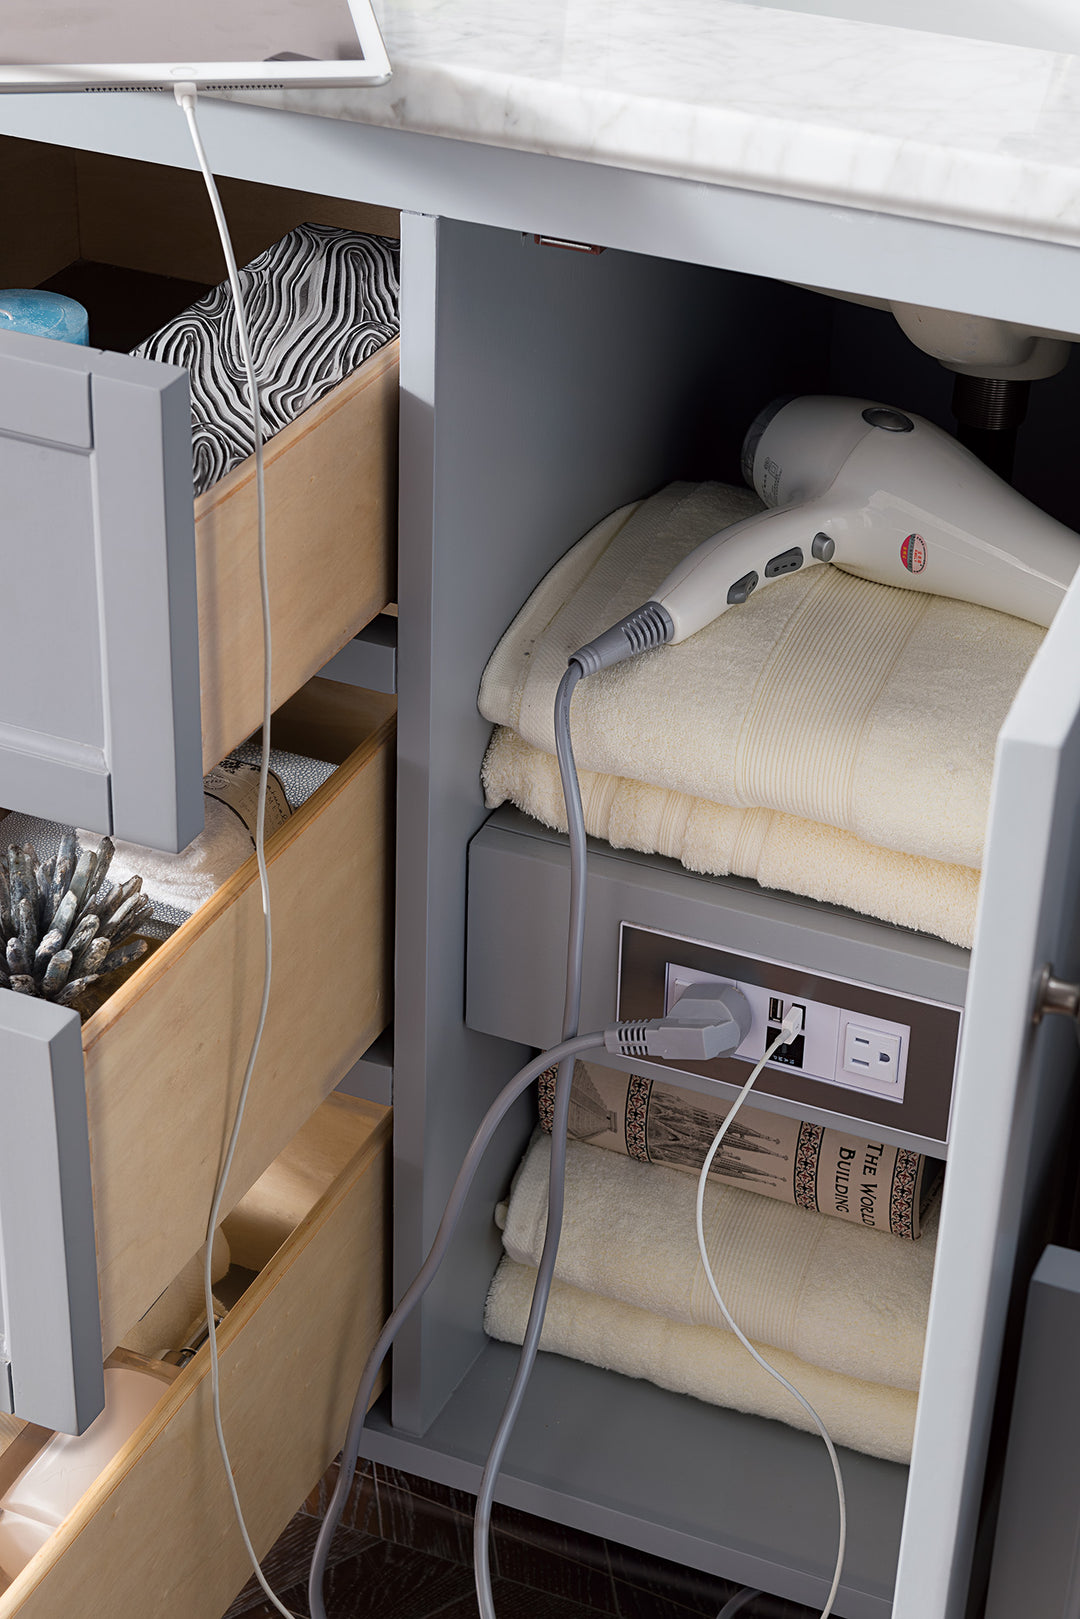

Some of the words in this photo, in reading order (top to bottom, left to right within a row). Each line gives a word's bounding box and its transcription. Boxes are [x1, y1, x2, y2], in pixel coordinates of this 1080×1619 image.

[834, 1146, 856, 1213] BUILDING
[863, 1144, 884, 1176] THE
[859, 1183, 878, 1227] WORLD
